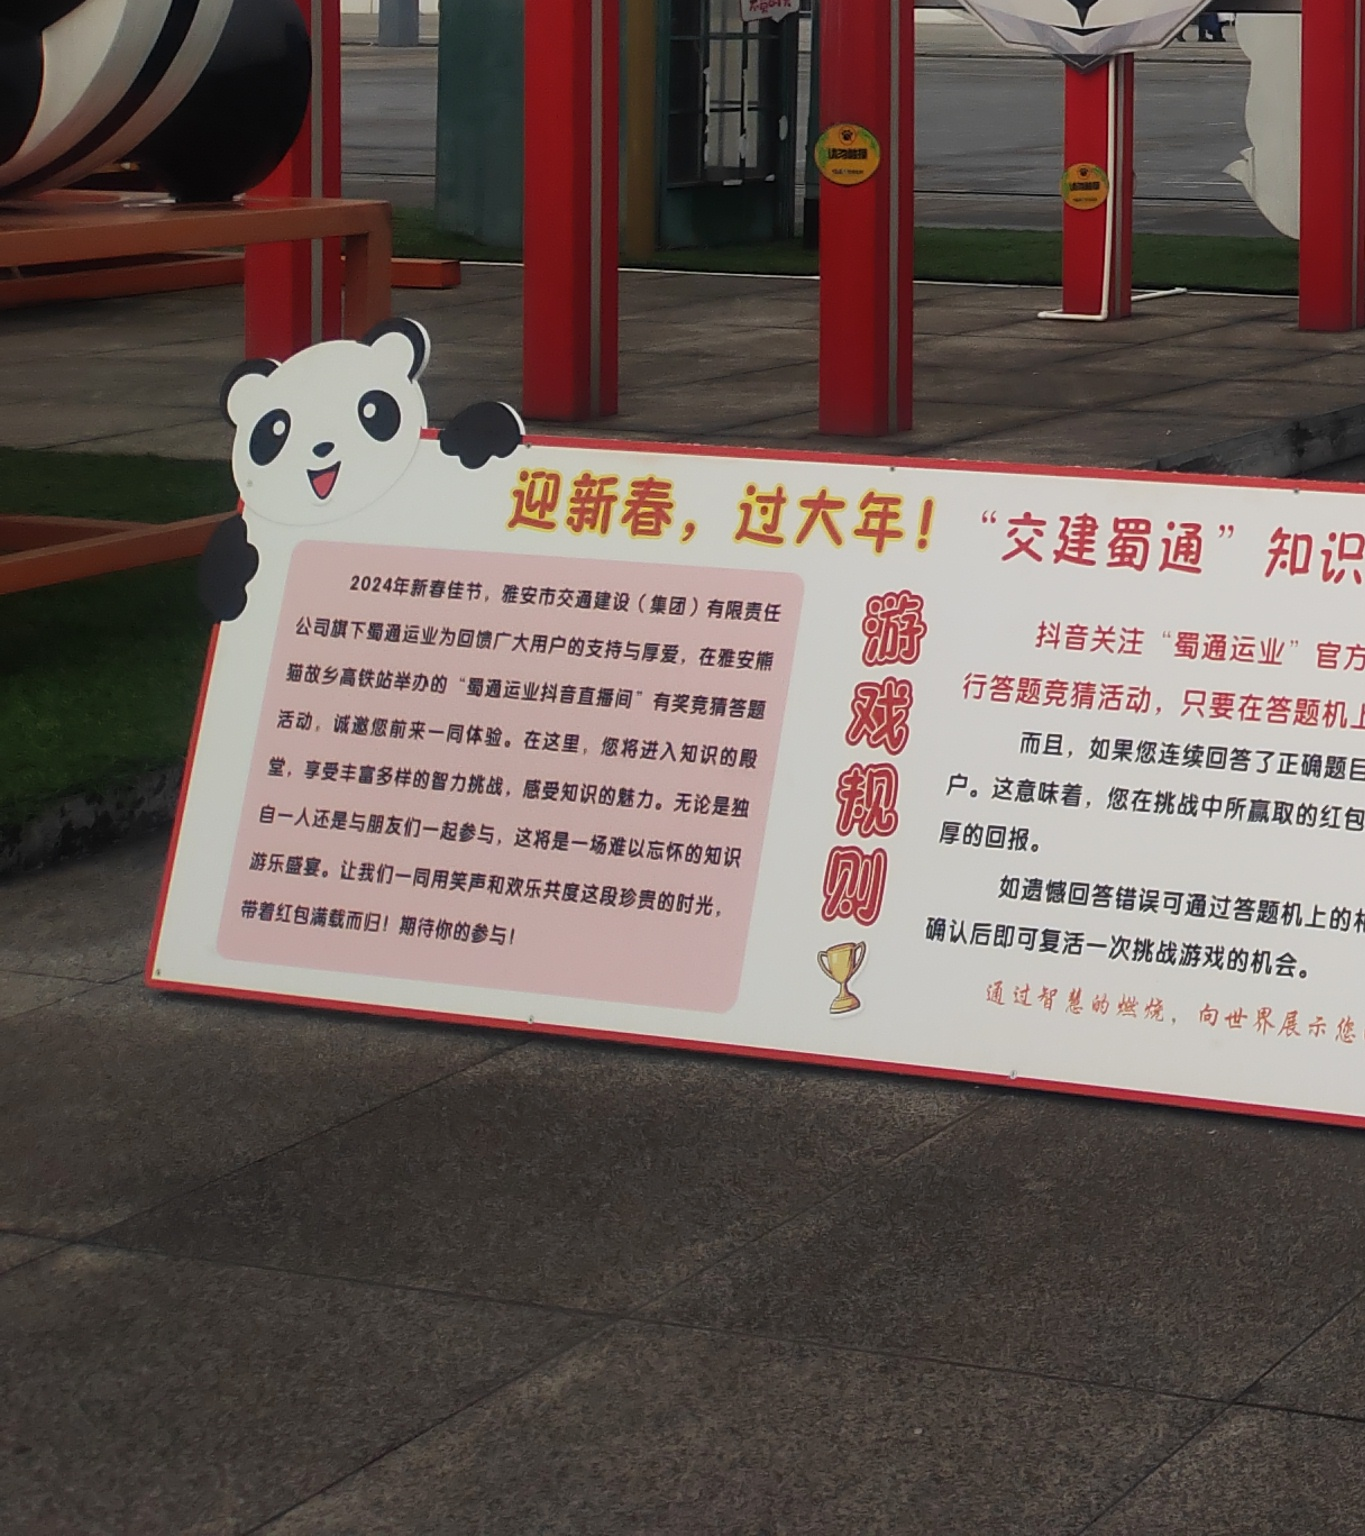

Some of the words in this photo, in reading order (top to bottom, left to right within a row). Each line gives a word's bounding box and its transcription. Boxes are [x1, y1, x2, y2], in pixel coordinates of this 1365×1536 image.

[821, 589, 928, 926] 游戏规则
[938, 821, 1041, 854] 厚的回报。
